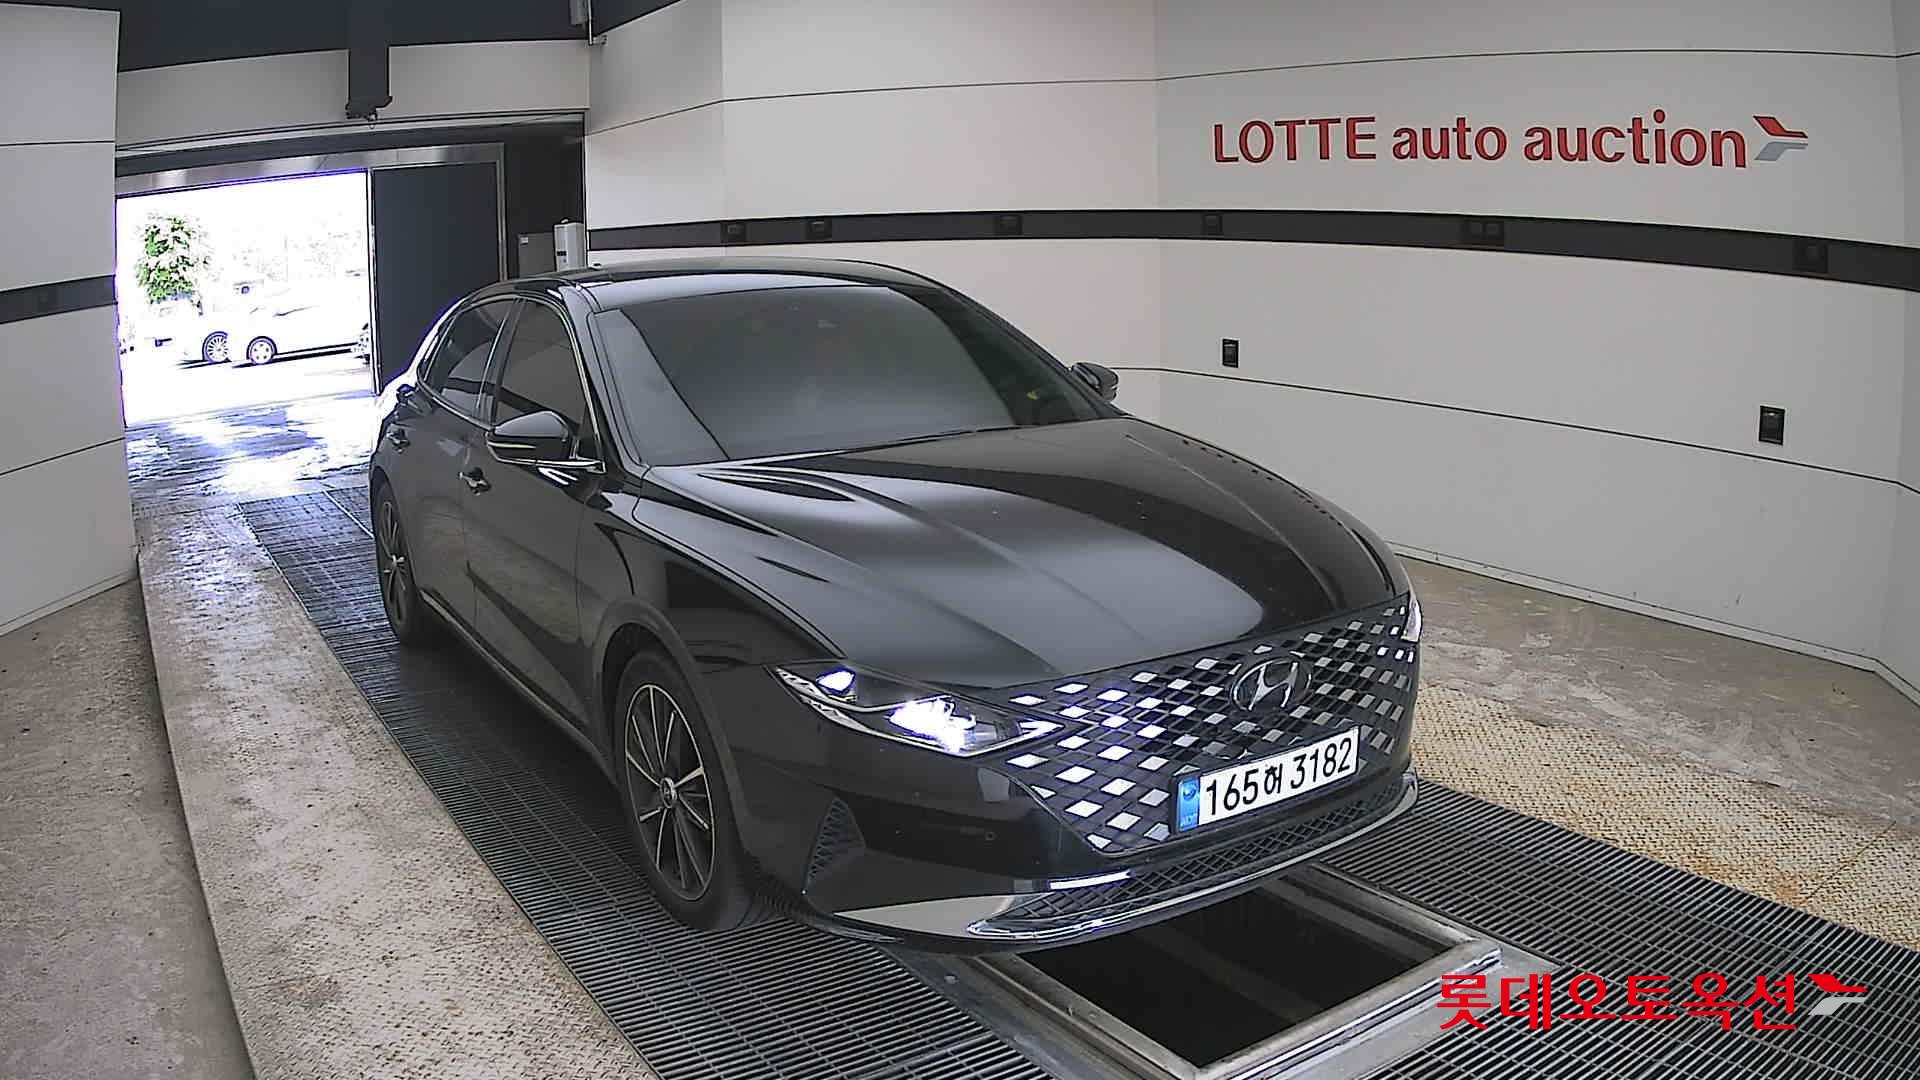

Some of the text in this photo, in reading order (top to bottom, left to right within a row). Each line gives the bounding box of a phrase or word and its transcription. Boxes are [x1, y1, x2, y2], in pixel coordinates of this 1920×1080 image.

[1213, 109, 1748, 169] LOTTE auto auction
[1206, 737, 1352, 816] 165허 3182
